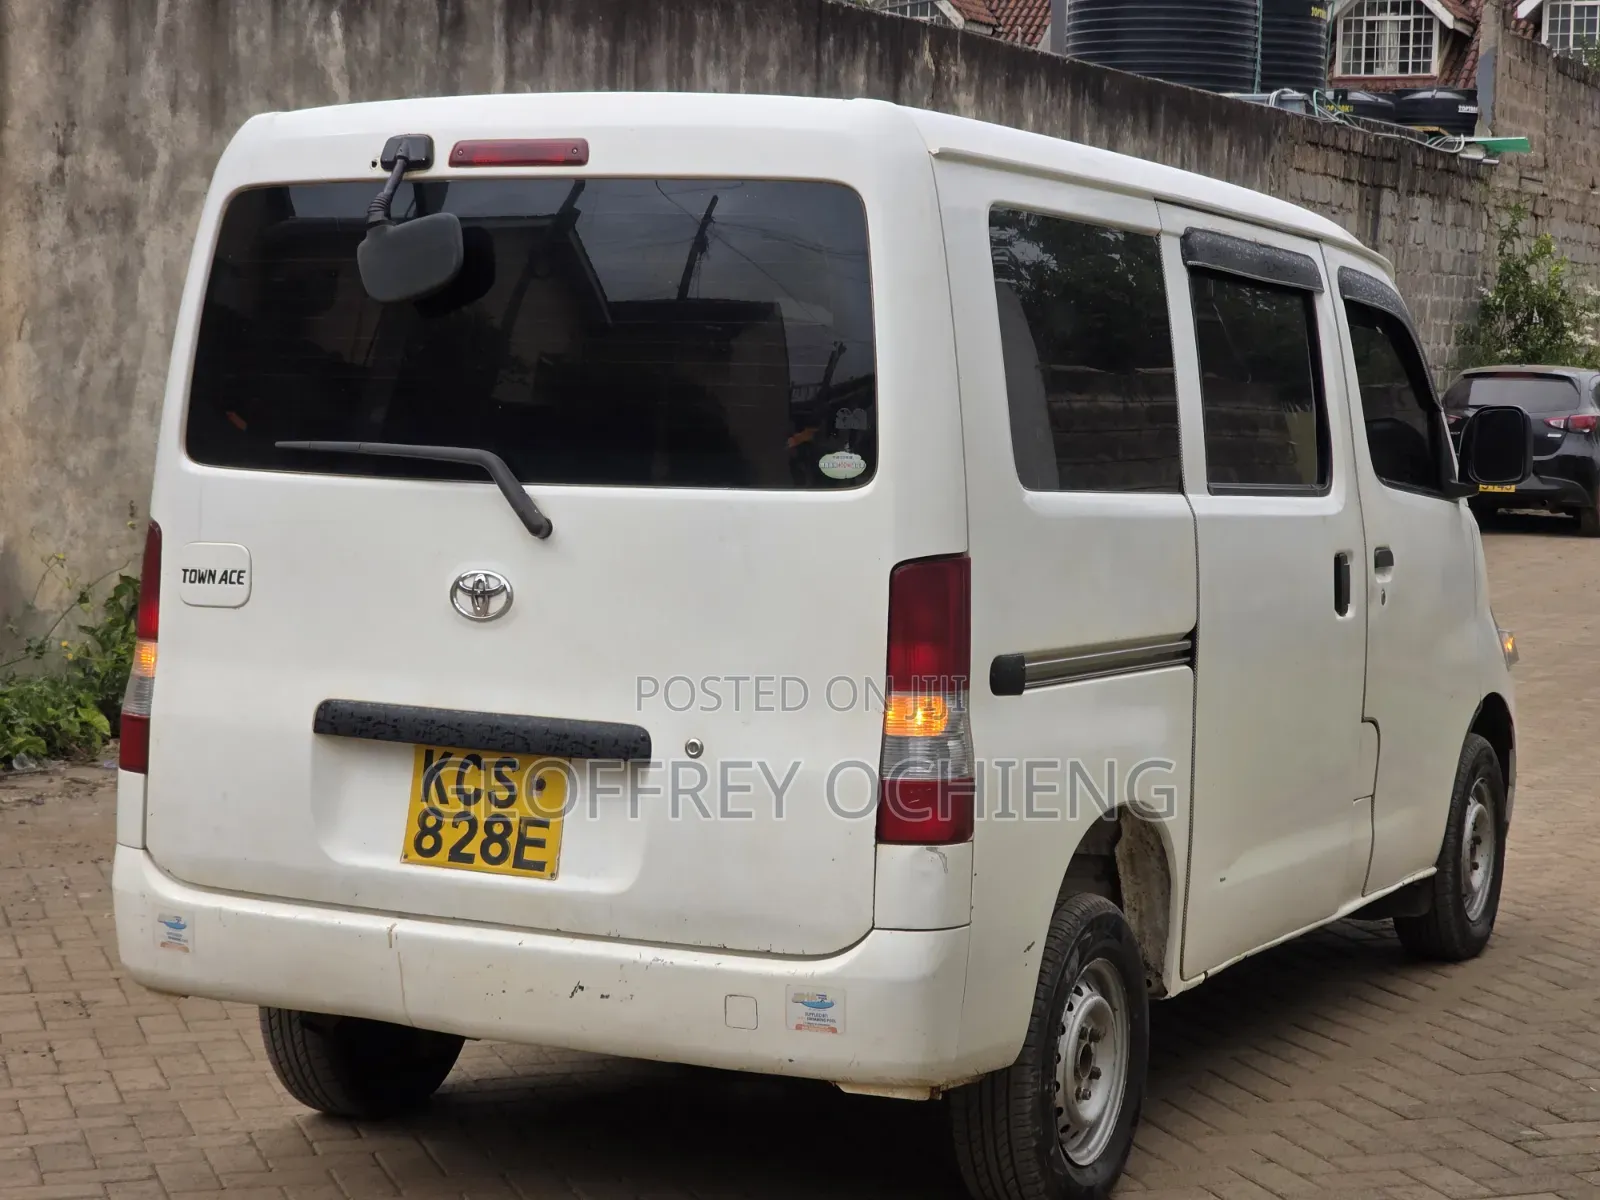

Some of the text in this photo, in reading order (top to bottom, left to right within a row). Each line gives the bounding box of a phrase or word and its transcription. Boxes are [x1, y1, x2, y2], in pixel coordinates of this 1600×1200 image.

[181, 568, 246, 586] TOWN ACE
[420, 749, 520, 809] KCS
[413, 806, 550, 872] 828E
